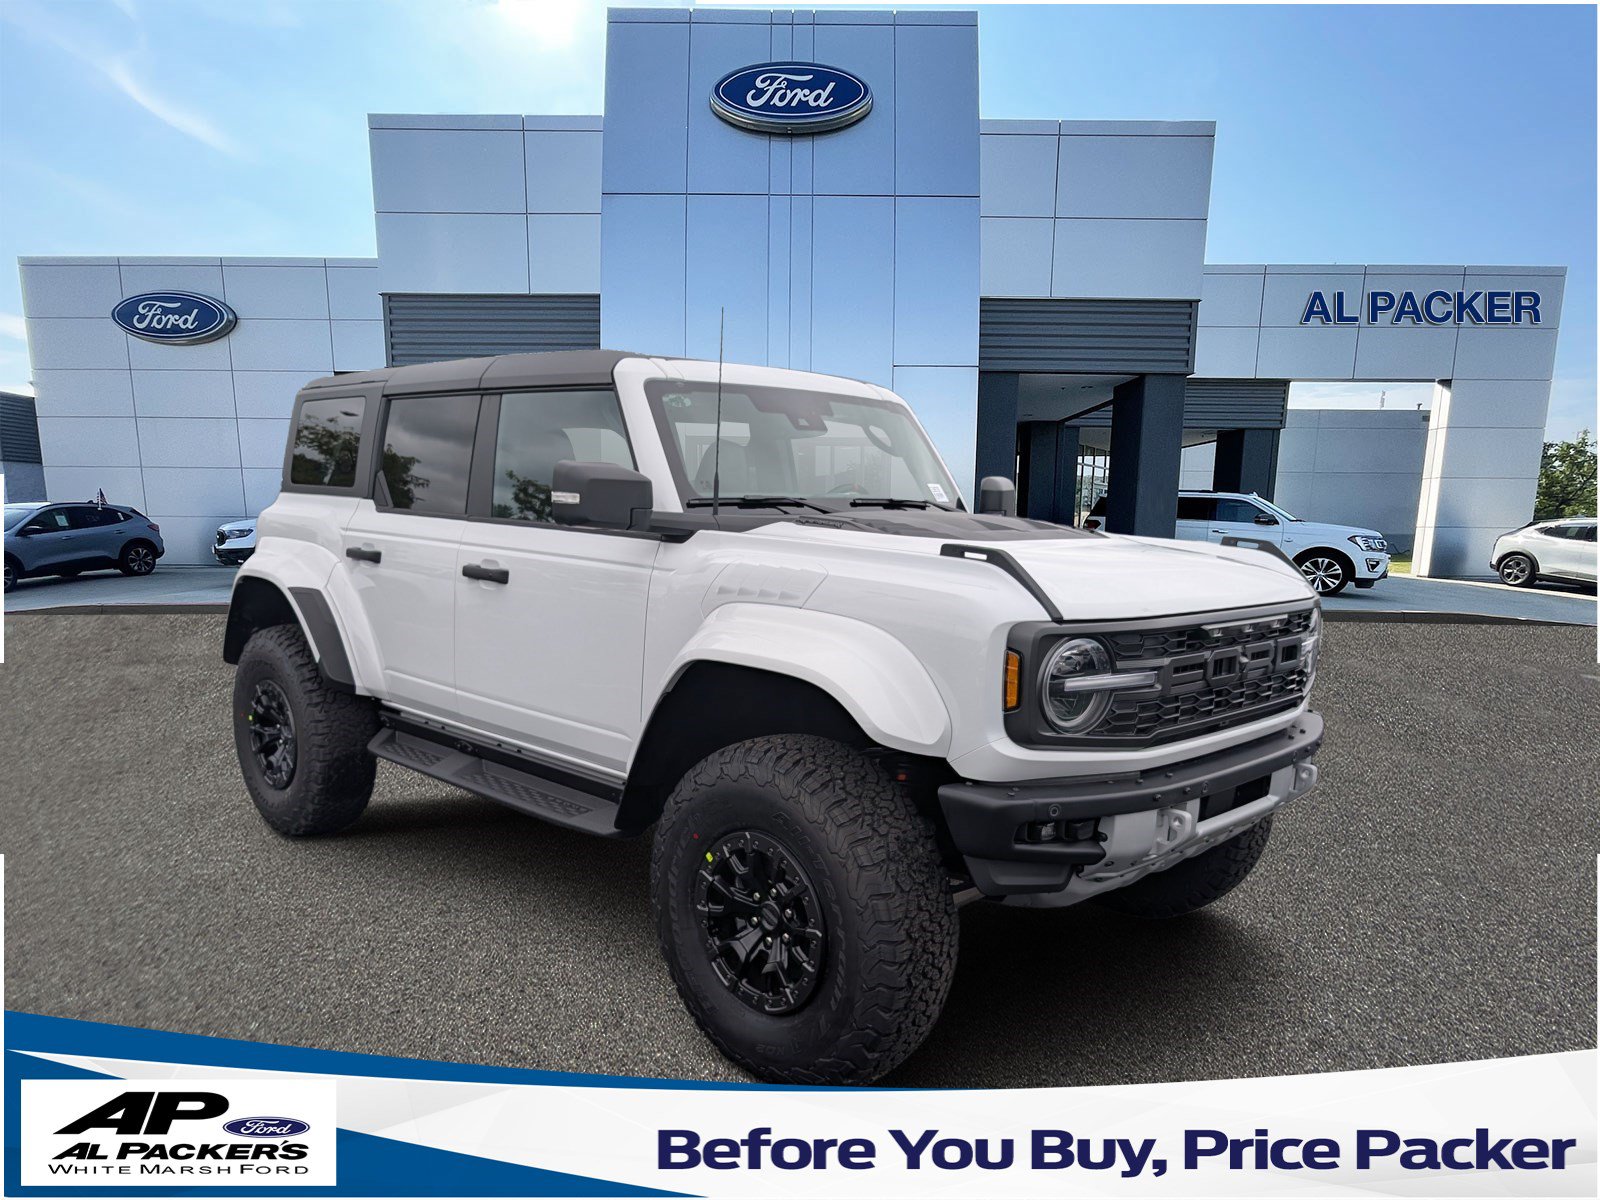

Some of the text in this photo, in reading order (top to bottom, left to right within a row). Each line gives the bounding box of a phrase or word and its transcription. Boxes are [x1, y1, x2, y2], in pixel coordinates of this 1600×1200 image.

[746, 73, 836, 107] Ford
[133, 301, 199, 329] Ford
[1301, 290, 1542, 324] AL PACKER
